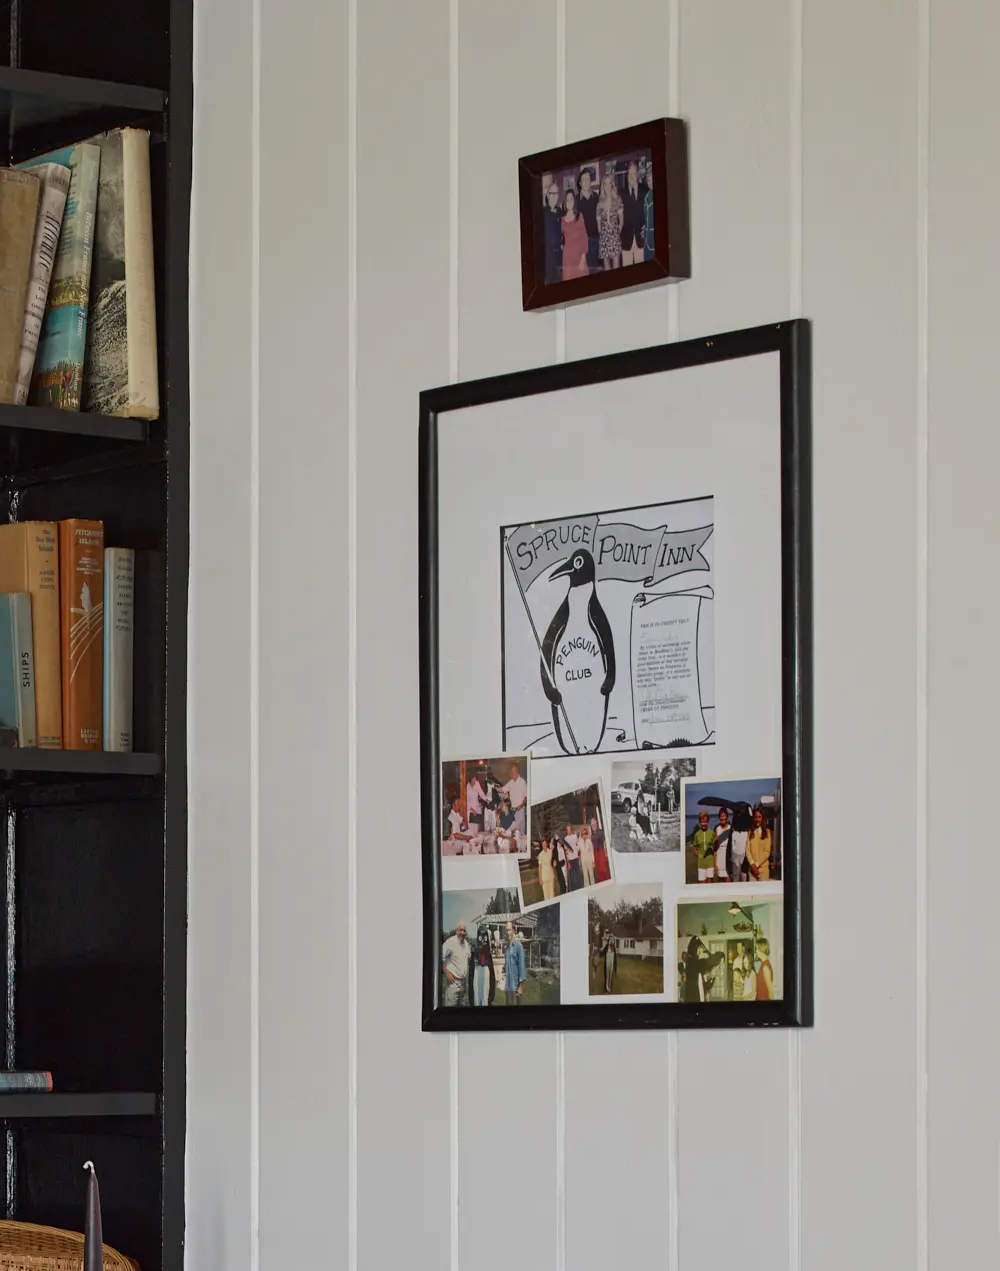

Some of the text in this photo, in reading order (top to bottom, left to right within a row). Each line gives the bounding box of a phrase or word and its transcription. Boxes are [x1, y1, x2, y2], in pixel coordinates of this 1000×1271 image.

[516, 524, 696, 570] SPRUCE POINT INN
[556, 636, 600, 666] PENGUIN
[22, 652, 30, 688] SHIPS
[565, 668, 592, 682] CLUB
